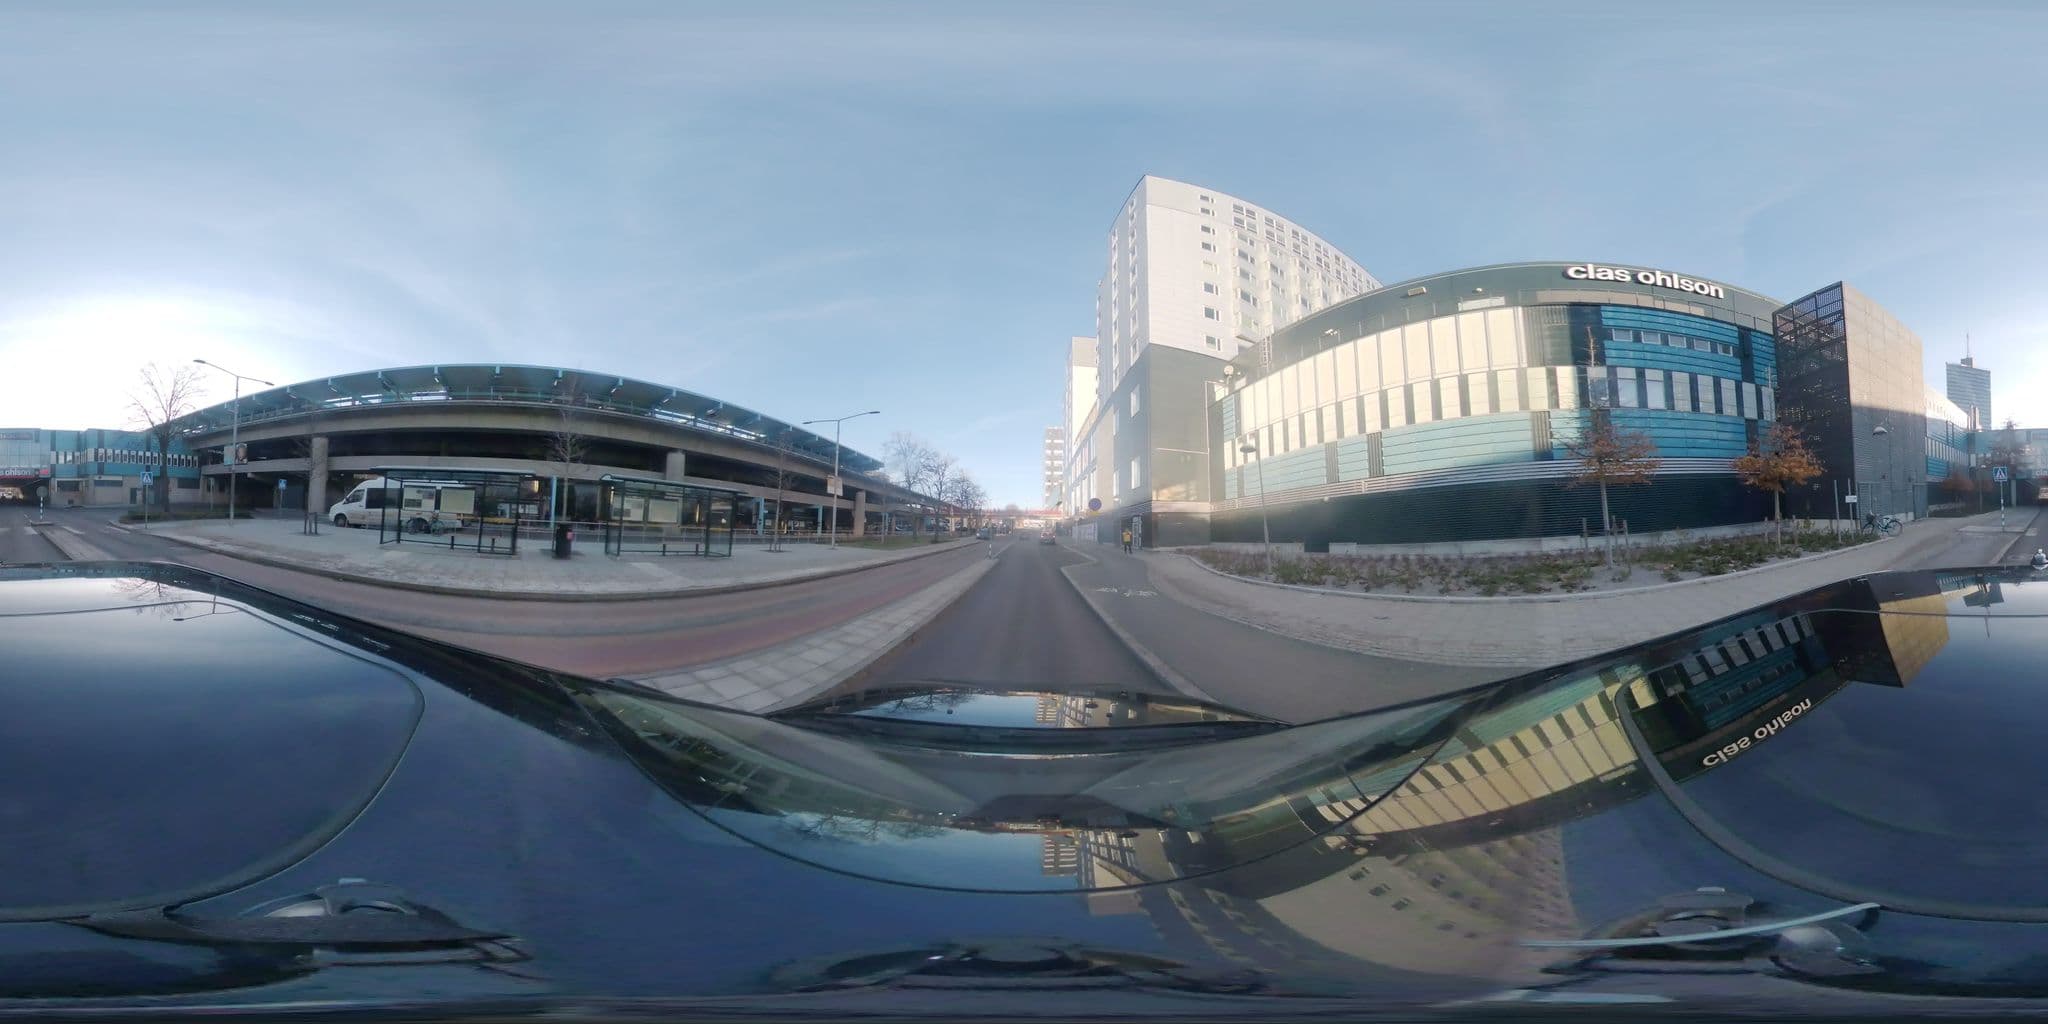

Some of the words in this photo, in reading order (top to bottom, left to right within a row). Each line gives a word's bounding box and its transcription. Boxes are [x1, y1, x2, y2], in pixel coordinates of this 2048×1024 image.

[1567, 263, 1632, 282] clas
[1636, 270, 1725, 299] ohlson
[5, 468, 30, 476] ohlson
